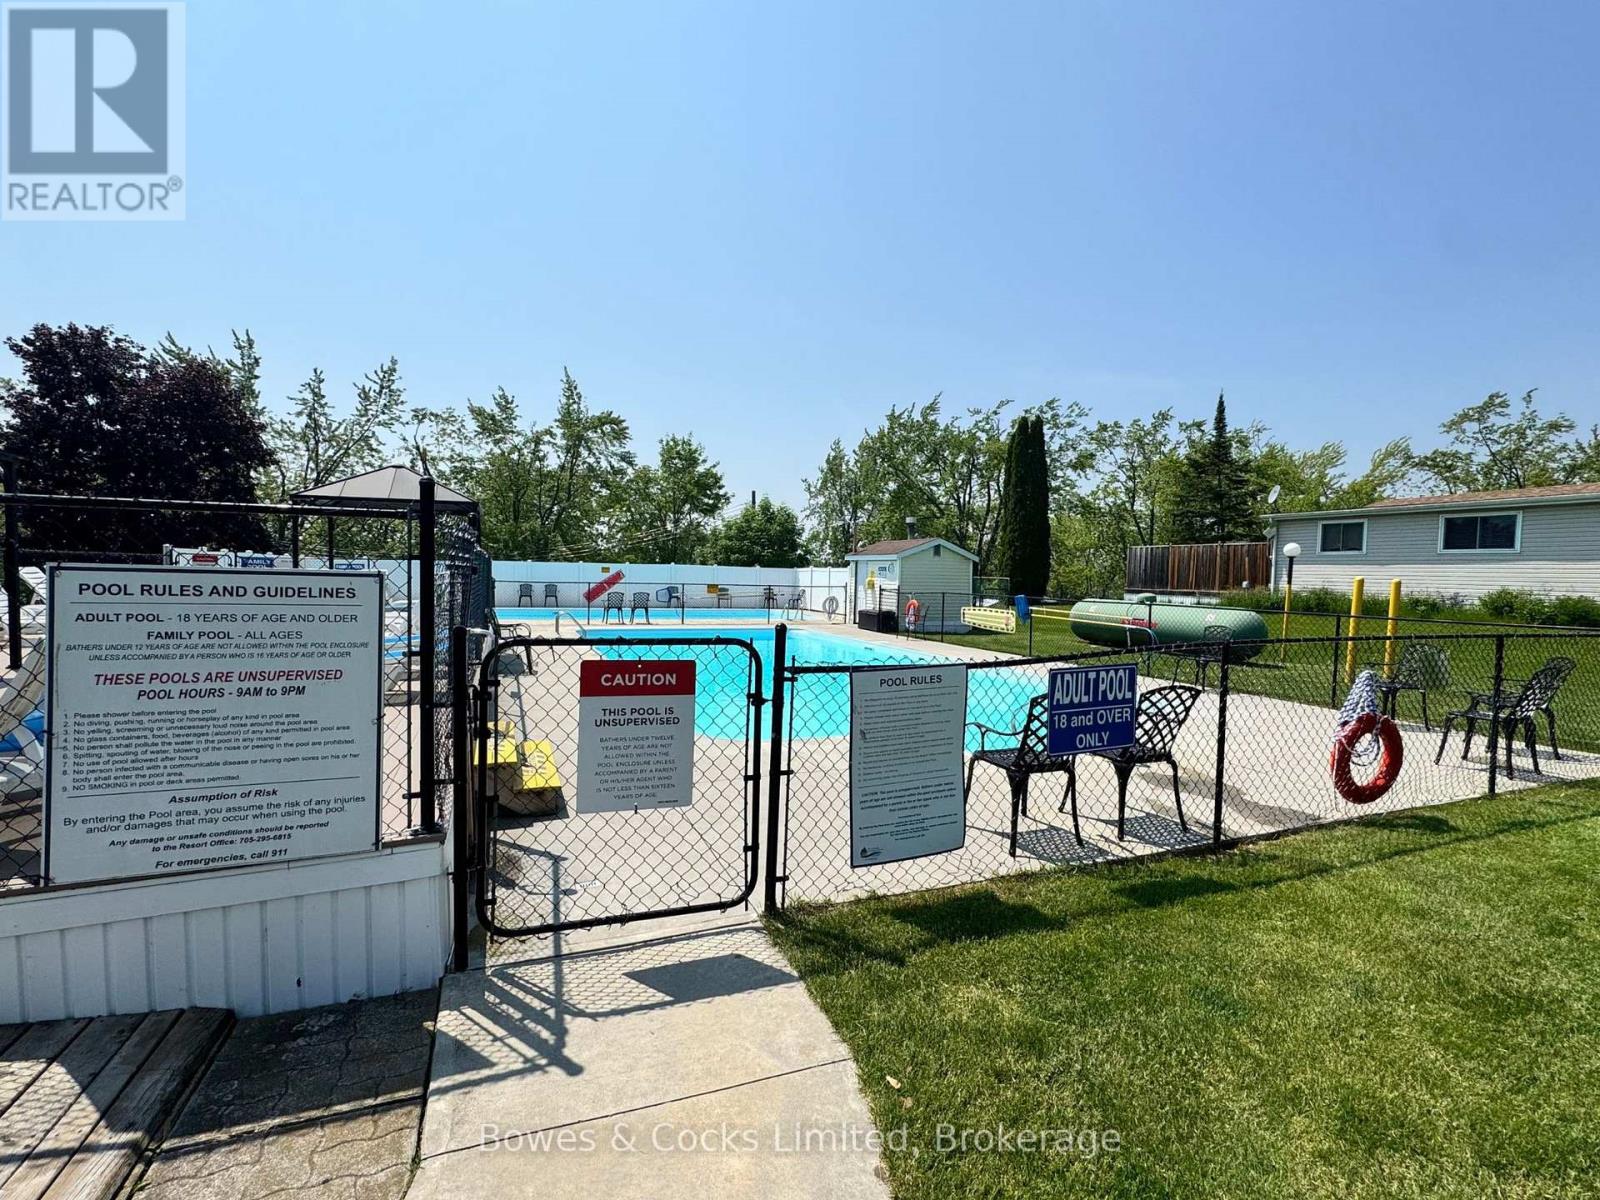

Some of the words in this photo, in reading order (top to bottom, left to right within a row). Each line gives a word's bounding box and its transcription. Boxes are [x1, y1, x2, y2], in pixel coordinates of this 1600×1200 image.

[79, 583, 135, 596] POOL
[140, 584, 204, 597] RULES
[208, 586, 248, 598] AND
[253, 586, 356, 599] GUIDELINES
[75, 613, 122, 622] ADULT
[126, 613, 165, 623] POOL
[177, 614, 191, 623] 18
[194, 614, 238, 623] YEARS
[241, 614, 258, 623] OF
[261, 614, 287, 623] AGE
[290, 614, 315, 623] AND
[318, 614, 358, 623] OLDER
[147, 631, 194, 640] FAMILY
[198, 631, 234, 640] POOL
[244, 631, 266, 640] ALL
[269, 631, 303, 640] AGES
[94, 673, 146, 686] THESE
[149, 672, 200, 685] POOLS
[203, 672, 235, 683] ARE
[238, 670, 343, 682] UNSUPERVISED
[601, 674, 676, 686] CAUTION
[880, 678, 907, 687] POOL
[910, 675, 942, 685] RULES
[137, 689, 175, 700] POOL
[178, 688, 225, 699] HOURS
[236, 687, 263, 698] 9AM
[266, 687, 278, 697] to
[281, 686, 306, 696] 9PM
[1053, 672, 1096, 705] ADULT
[1099, 670, 1132, 701] POOL
[601, 708, 627, 717] THIS
[630, 707, 661, 716] POOL
[665, 707, 674, 715] IS
[1054, 714, 1067, 728] 18
[1071, 712, 1093, 727] and
[1097, 708, 1131, 724] OVER
[595, 717, 680, 728] UNSUPERVISED
[1076, 732, 1109, 748] ONLY
[168, 792, 237, 804] Assumption
[240, 790, 252, 799] of
[254, 788, 278, 798] Risk
[64, 818, 79, 828] By
[81, 815, 126, 826] entering
[149, 810, 172, 819] Pool
[175, 810, 201, 819] area,
[204, 808, 223, 817] you
[225, 804, 264, 813] assume
[284, 800, 301, 808] risk
[303, 798, 313, 807] of
[334, 796, 366, 805] injuries
[86, 824, 122, 834] and/or
[124, 821, 173, 831] damages
[176, 818, 195, 826] that
[198, 816, 220, 825] may
[222, 814, 250, 823] occur
[252, 812, 278, 820] when
[281, 809, 306, 818] using
[129, 837, 165, 845] damage
[178, 832, 207, 841] unsafe
[209, 829, 253, 838] conditions
[255, 825, 283, 834] should
[296, 821, 330, 831] reported
[179, 842, 208, 850] Resort
[155, 861, 175, 869] For
[177, 854, 247, 867] emergencies,
[250, 850, 269, 859] call
[271, 848, 288, 857] 911
